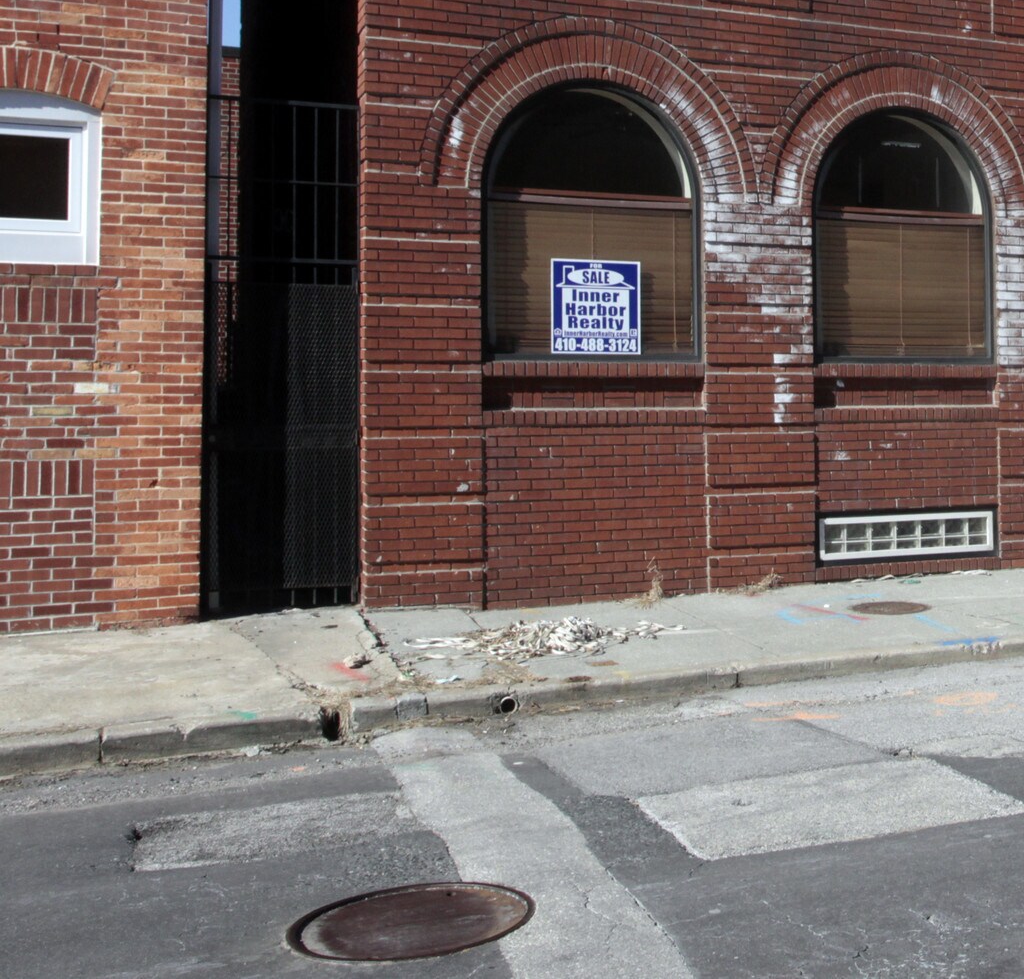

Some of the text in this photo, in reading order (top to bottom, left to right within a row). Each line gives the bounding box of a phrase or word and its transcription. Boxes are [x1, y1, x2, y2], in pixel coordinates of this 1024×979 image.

[582, 270, 610, 284] SALE
[572, 289, 620, 303] Inner
[565, 303, 627, 317] Harbor
[568, 316, 624, 331] Realty
[555, 337, 637, 352] 410-488-3124
